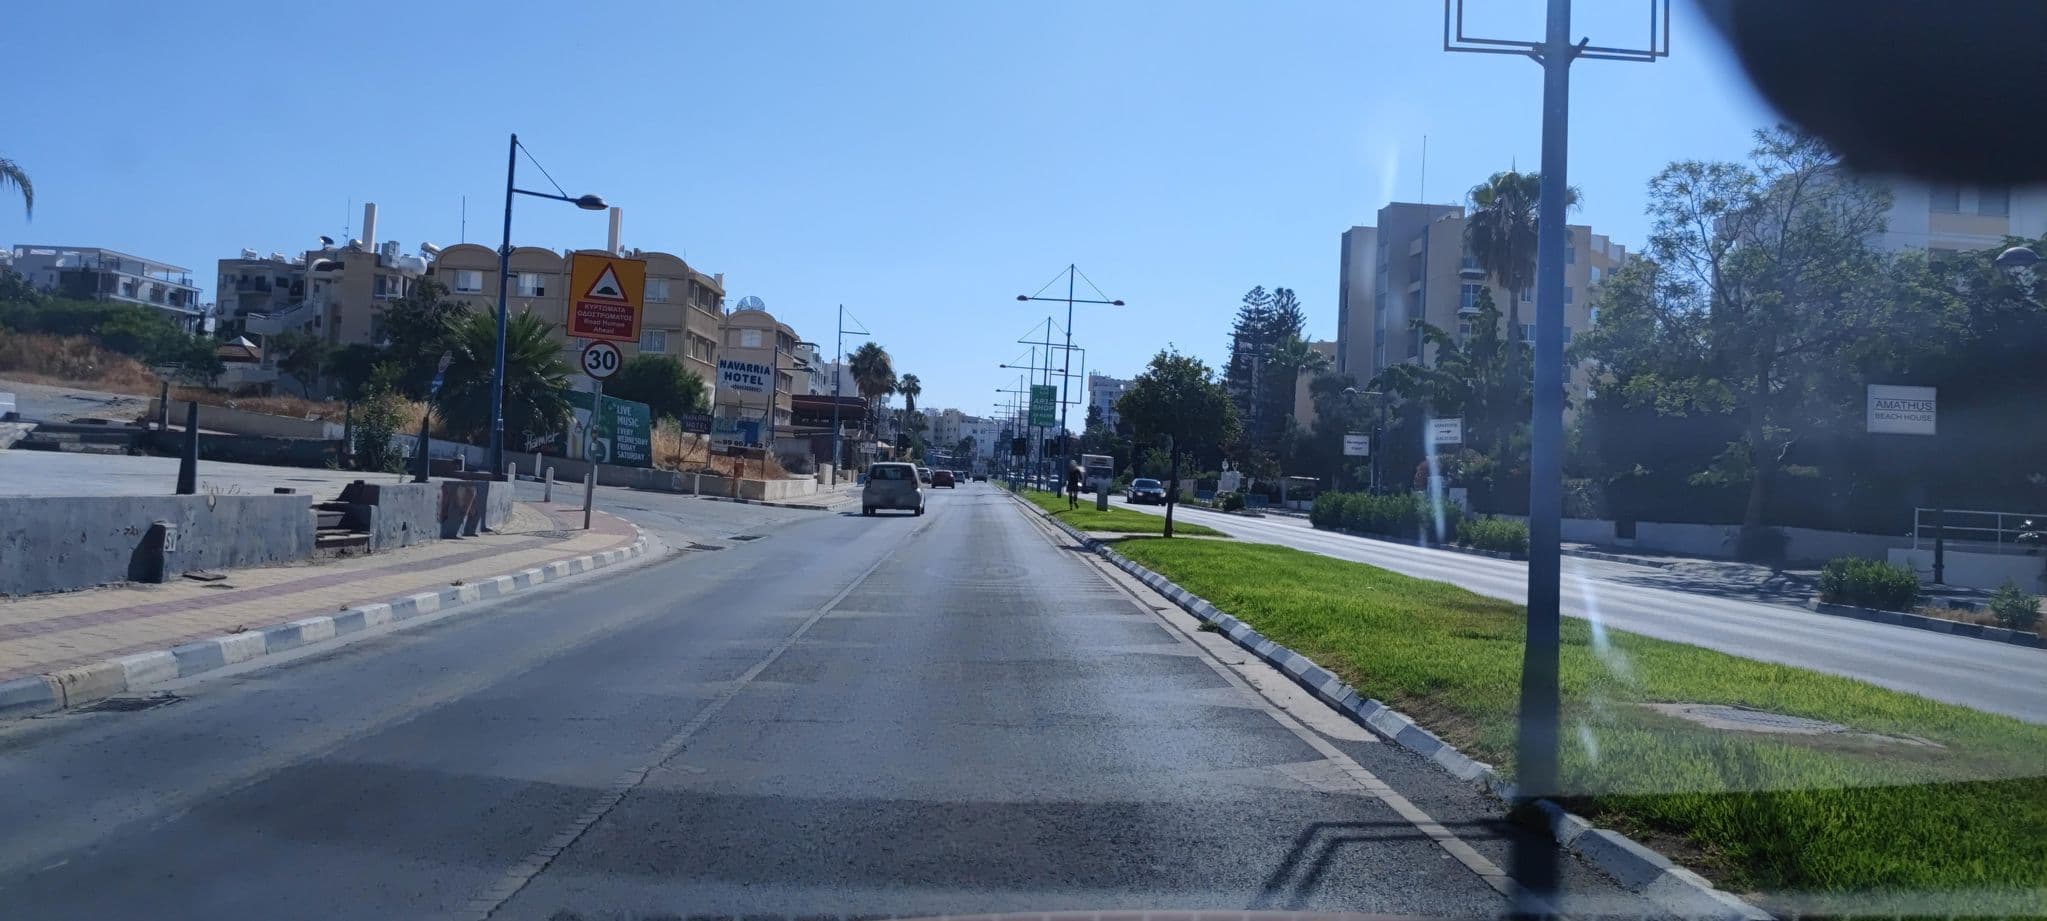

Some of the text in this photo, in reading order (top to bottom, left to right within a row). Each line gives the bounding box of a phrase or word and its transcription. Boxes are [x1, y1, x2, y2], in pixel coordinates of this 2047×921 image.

[587, 349, 616, 371] 30
[719, 360, 770, 375] NAVARRIA
[724, 371, 764, 386] HOTEL
[616, 405, 632, 416] LIVE
[1875, 400, 1933, 411] AMATHUS
[616, 416, 640, 428] MUSIC
[1874, 411, 1933, 422] BEACH HOUSE
[616, 427, 634, 437] EVERY
[616, 435, 649, 446] WEDNESDAY
[616, 443, 637, 452] FRIDAY
[616, 451, 646, 460] SATURDAY
